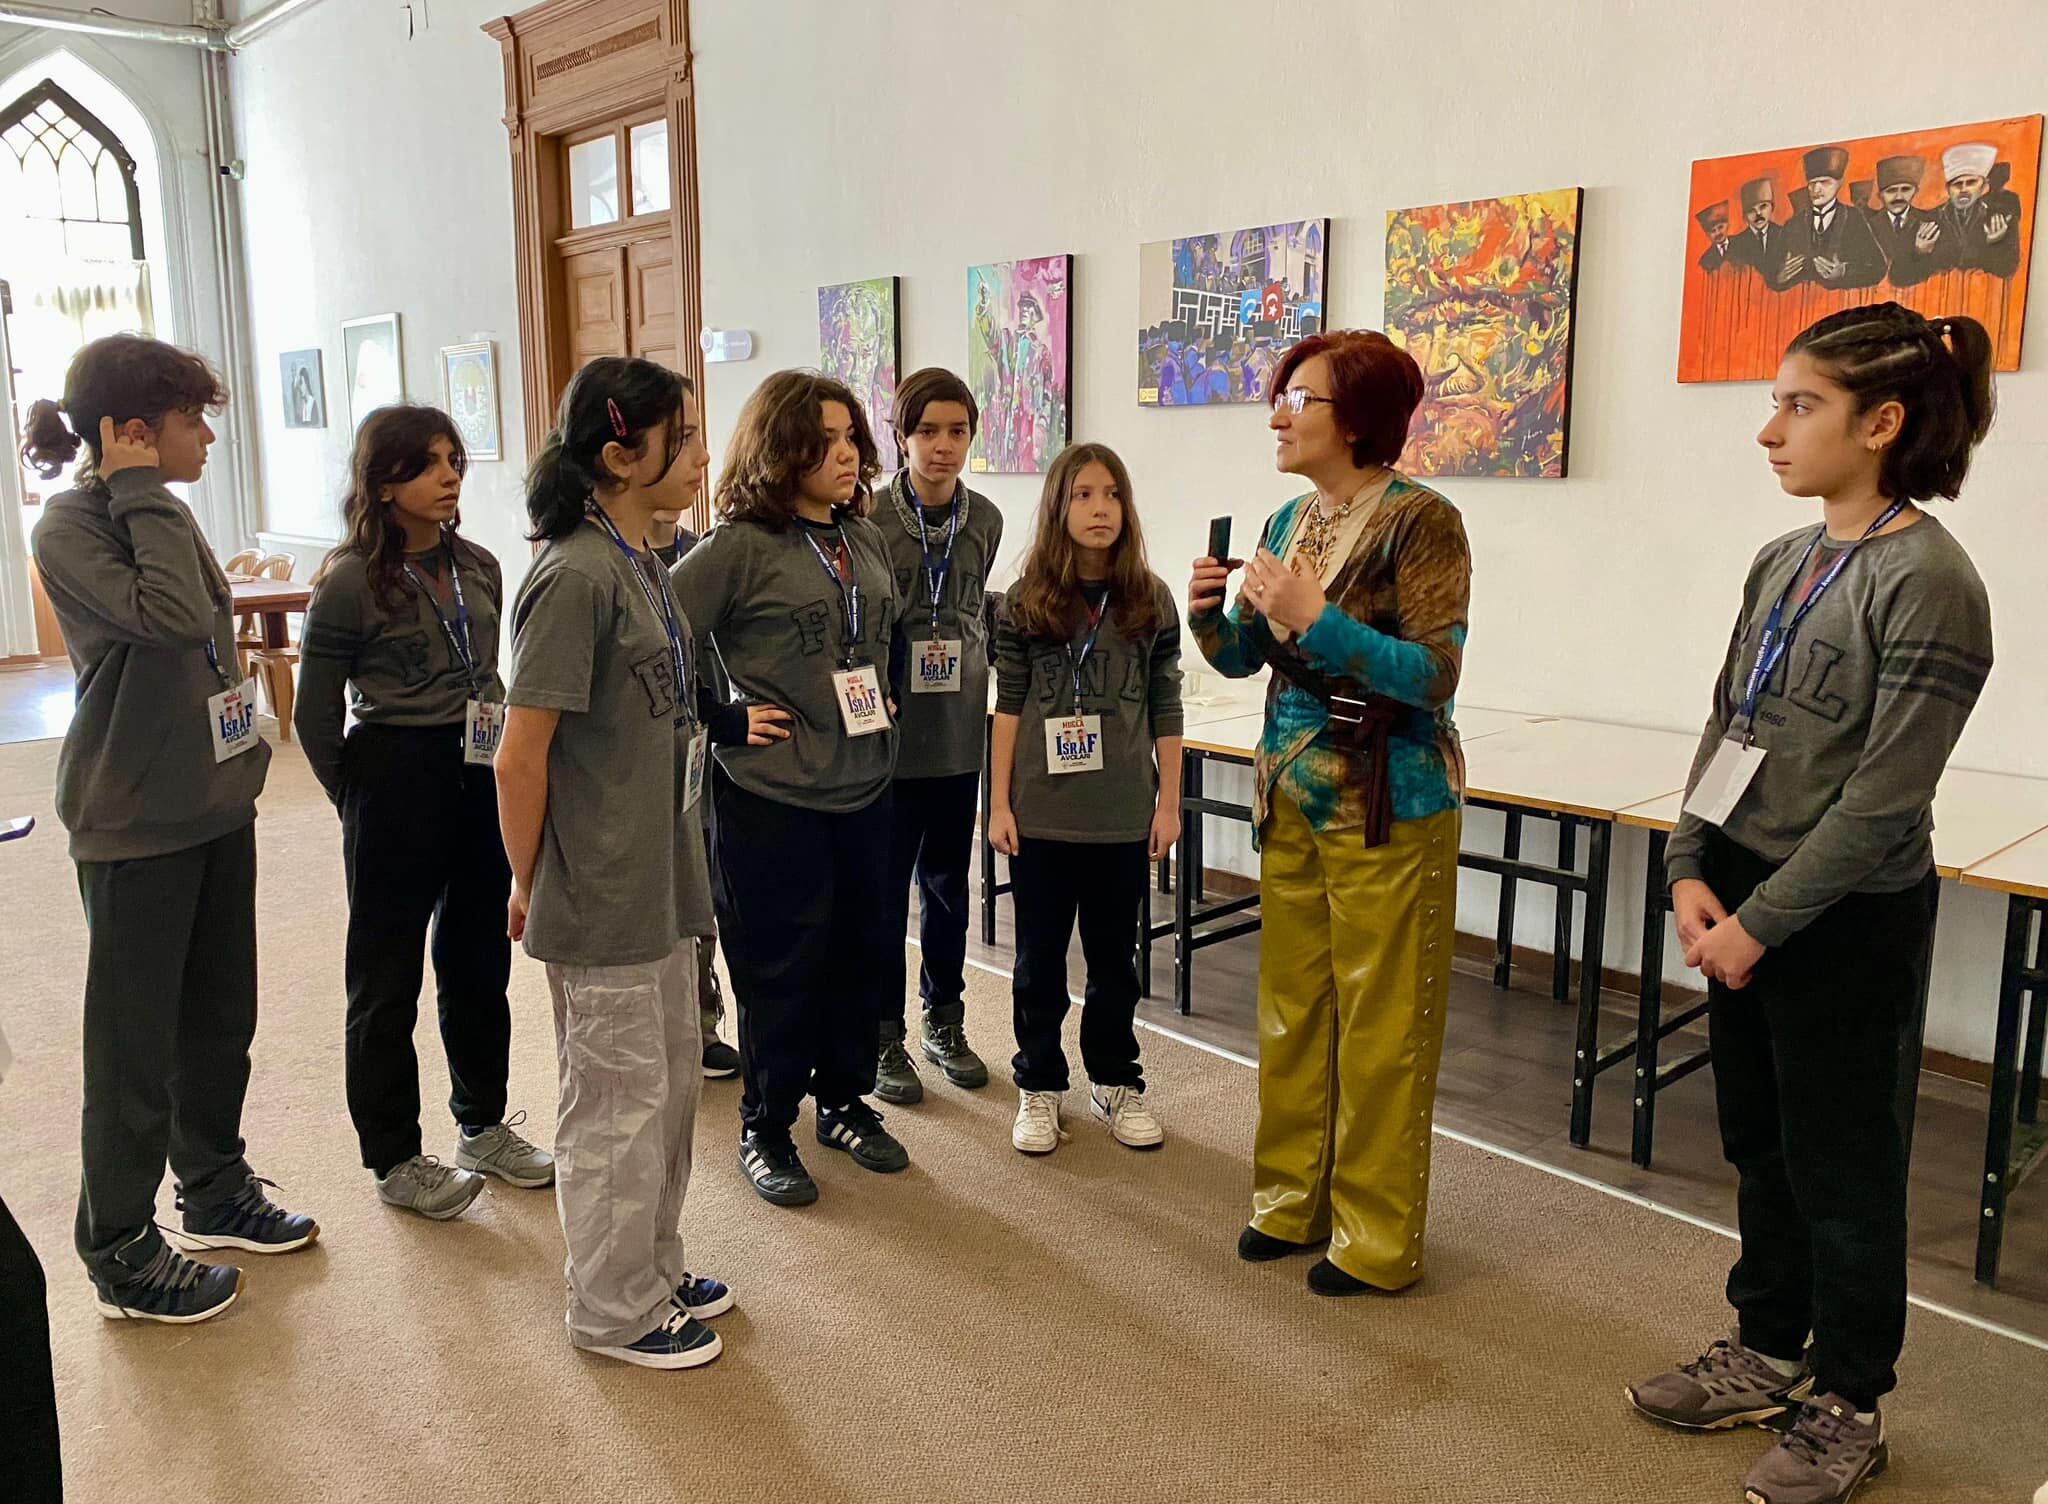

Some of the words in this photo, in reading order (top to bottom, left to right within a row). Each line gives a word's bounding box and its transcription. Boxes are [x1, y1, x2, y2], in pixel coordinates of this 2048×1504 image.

[920, 654, 958, 676] İSRAF
[845, 688, 877, 714] İSRAF
[218, 703, 254, 740] İSRAF
[1056, 732, 1098, 756] İSRAF
